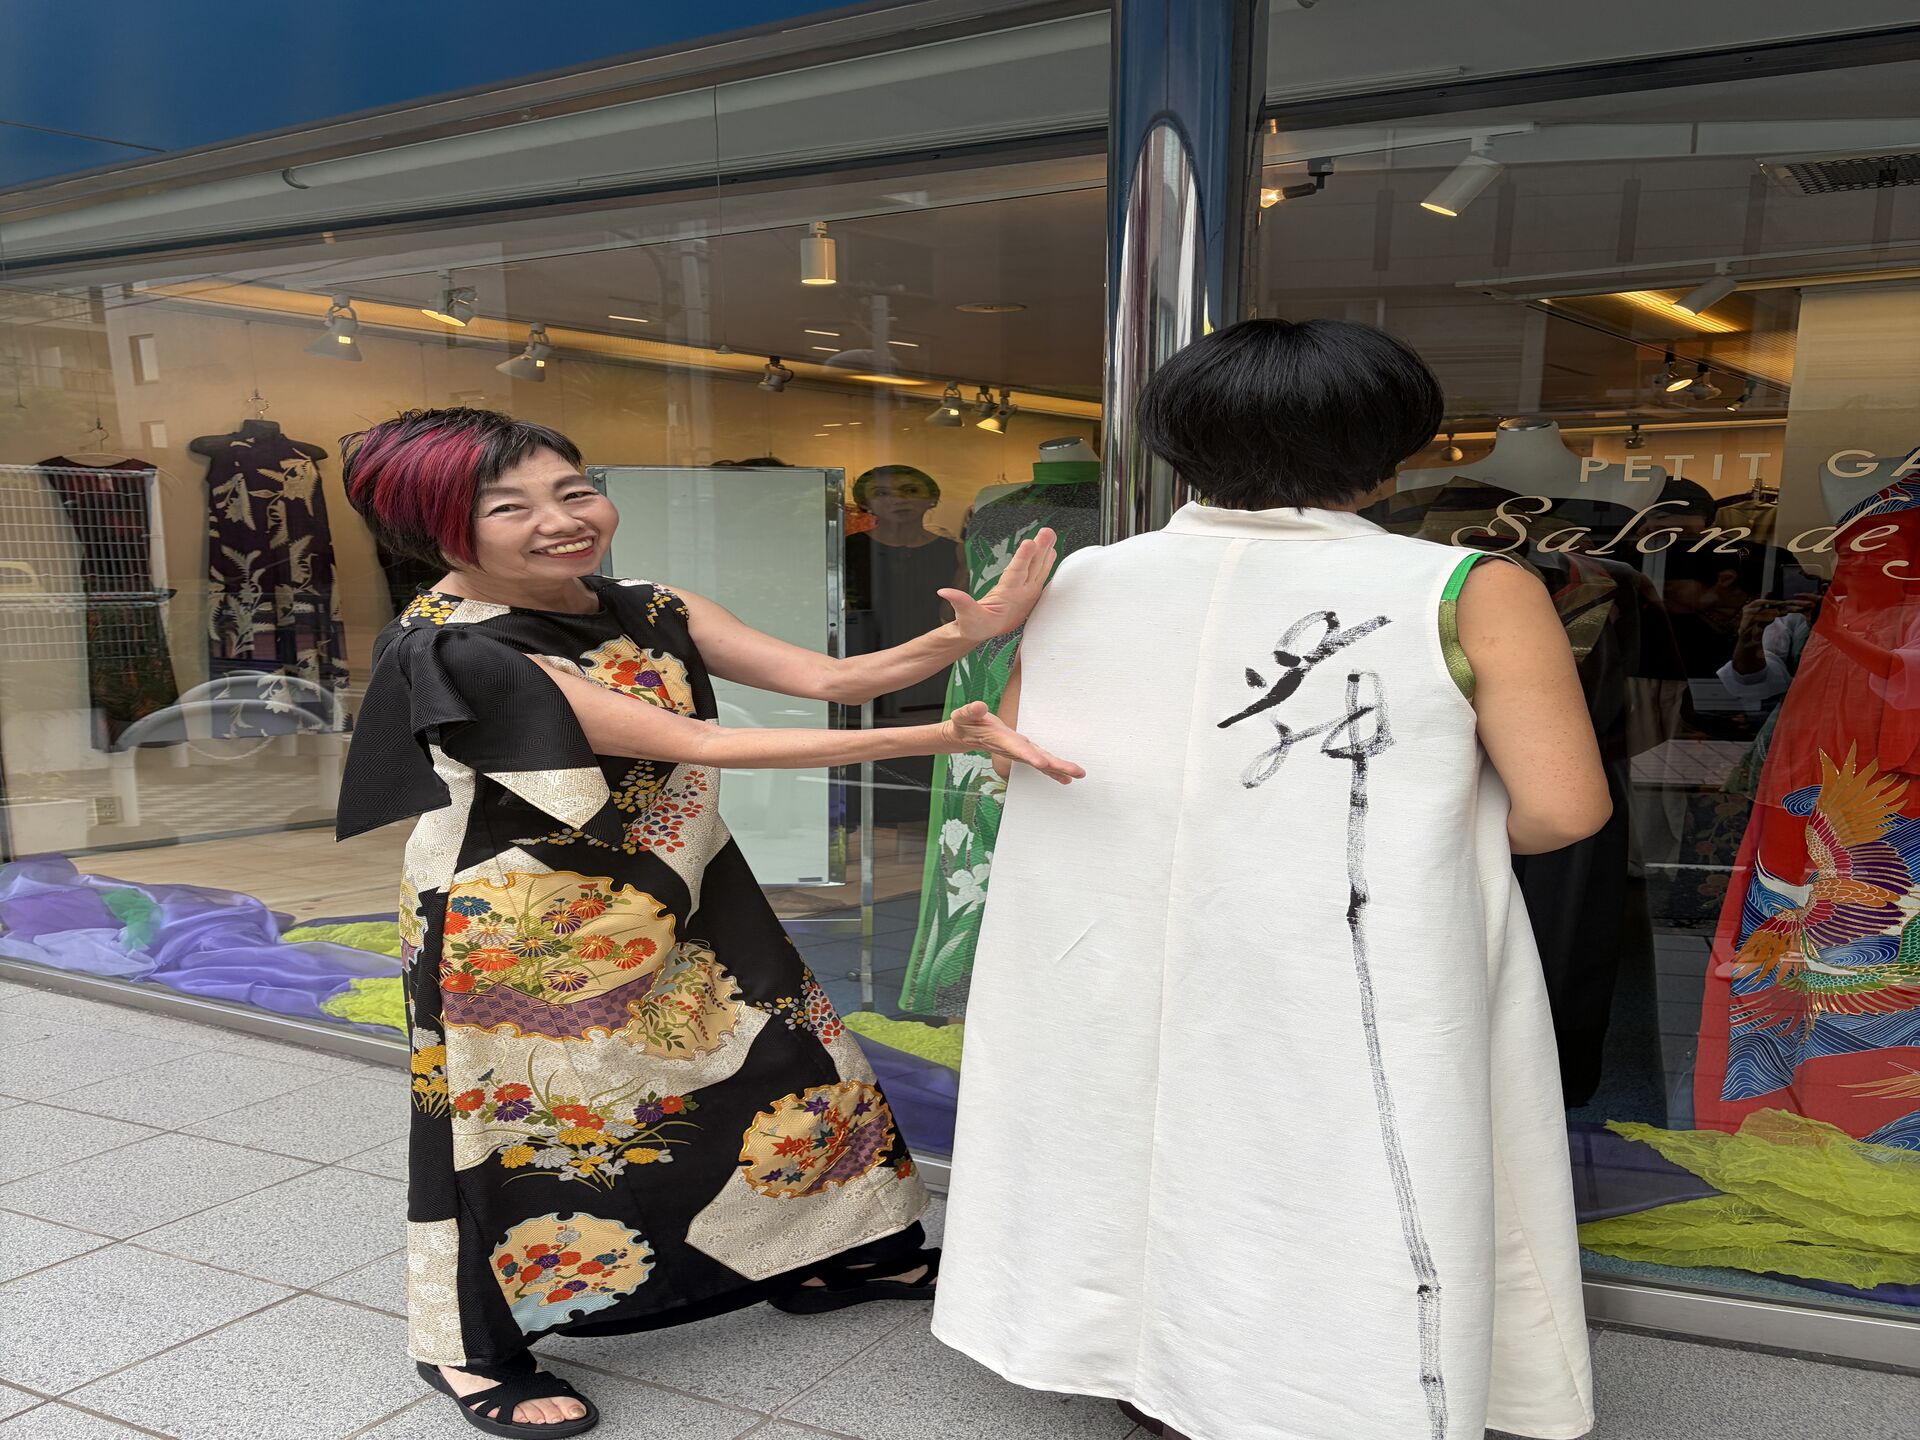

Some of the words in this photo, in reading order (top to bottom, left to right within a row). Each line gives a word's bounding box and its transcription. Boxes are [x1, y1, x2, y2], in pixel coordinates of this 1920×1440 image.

[1579, 451, 1771, 483] PETIT
[1450, 495, 1751, 554] Salon
[1786, 496, 1911, 553] de
